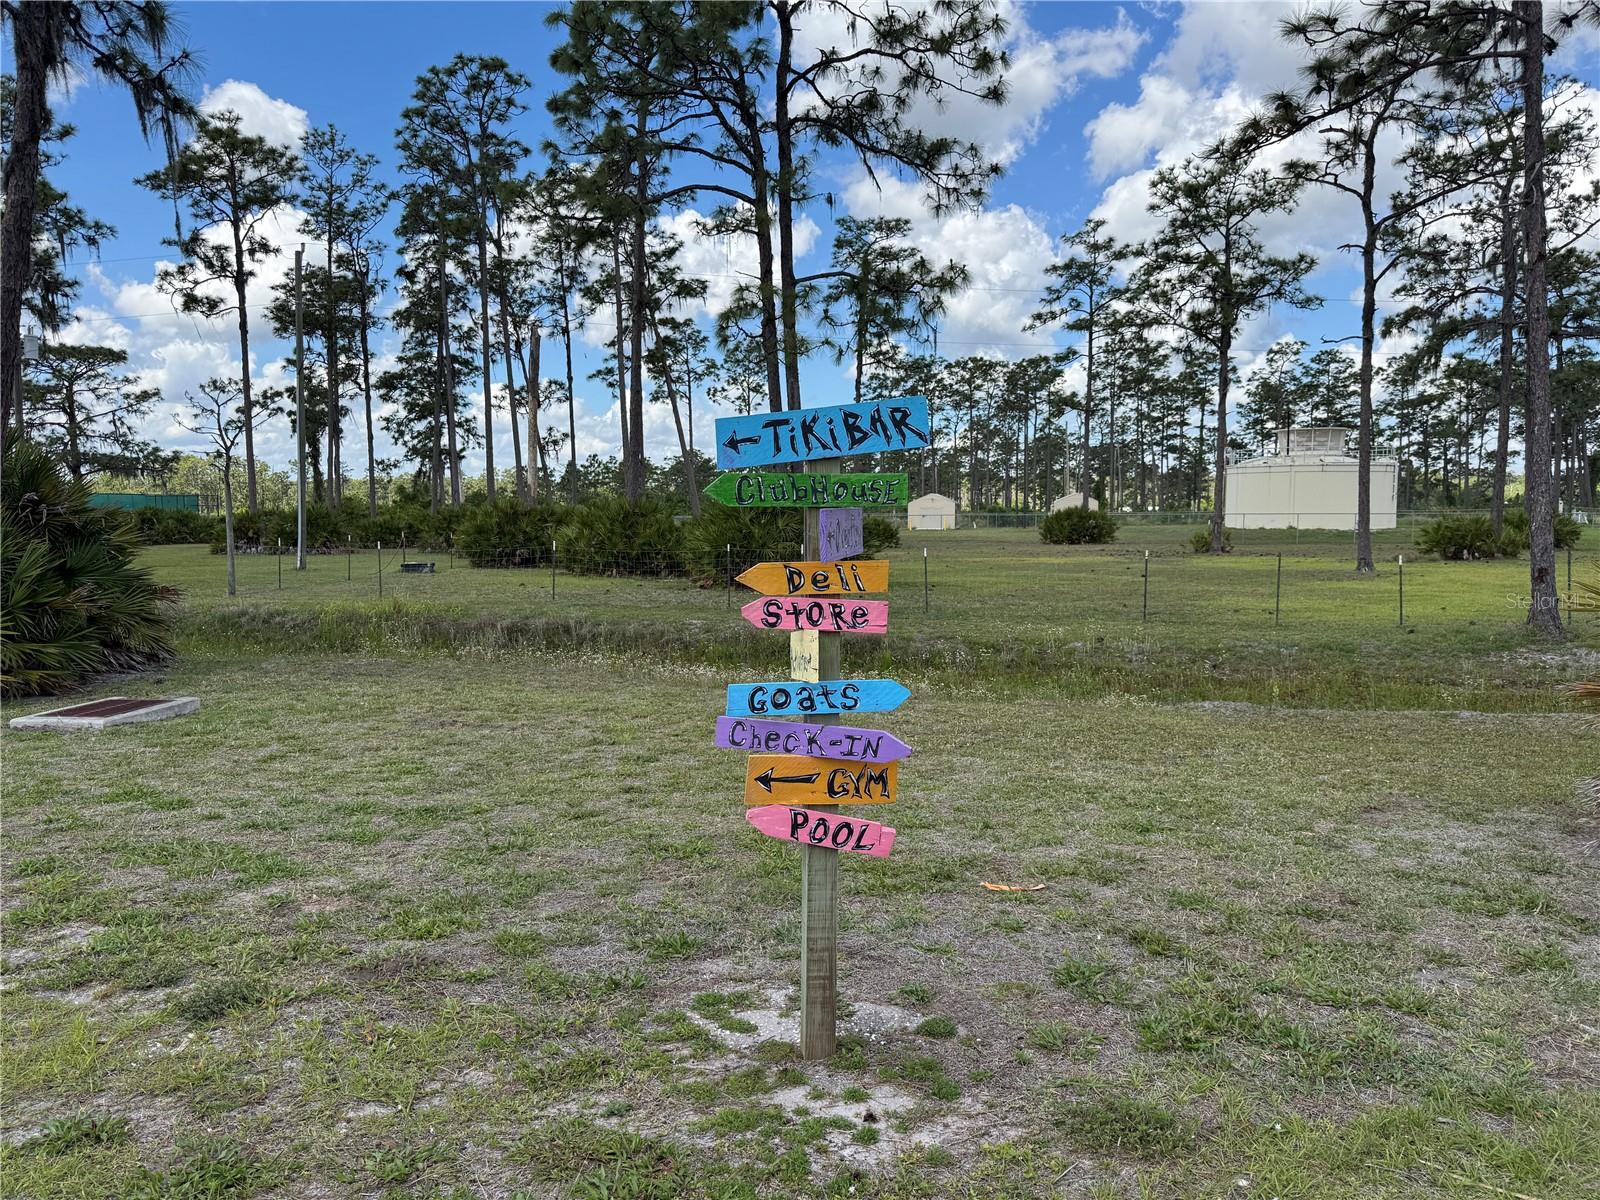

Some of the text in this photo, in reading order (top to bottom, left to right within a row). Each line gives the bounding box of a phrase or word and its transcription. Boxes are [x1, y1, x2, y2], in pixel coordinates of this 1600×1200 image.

[783, 563, 866, 595] Deli
[826, 764, 890, 799] GYM
[789, 808, 876, 851] POOL
